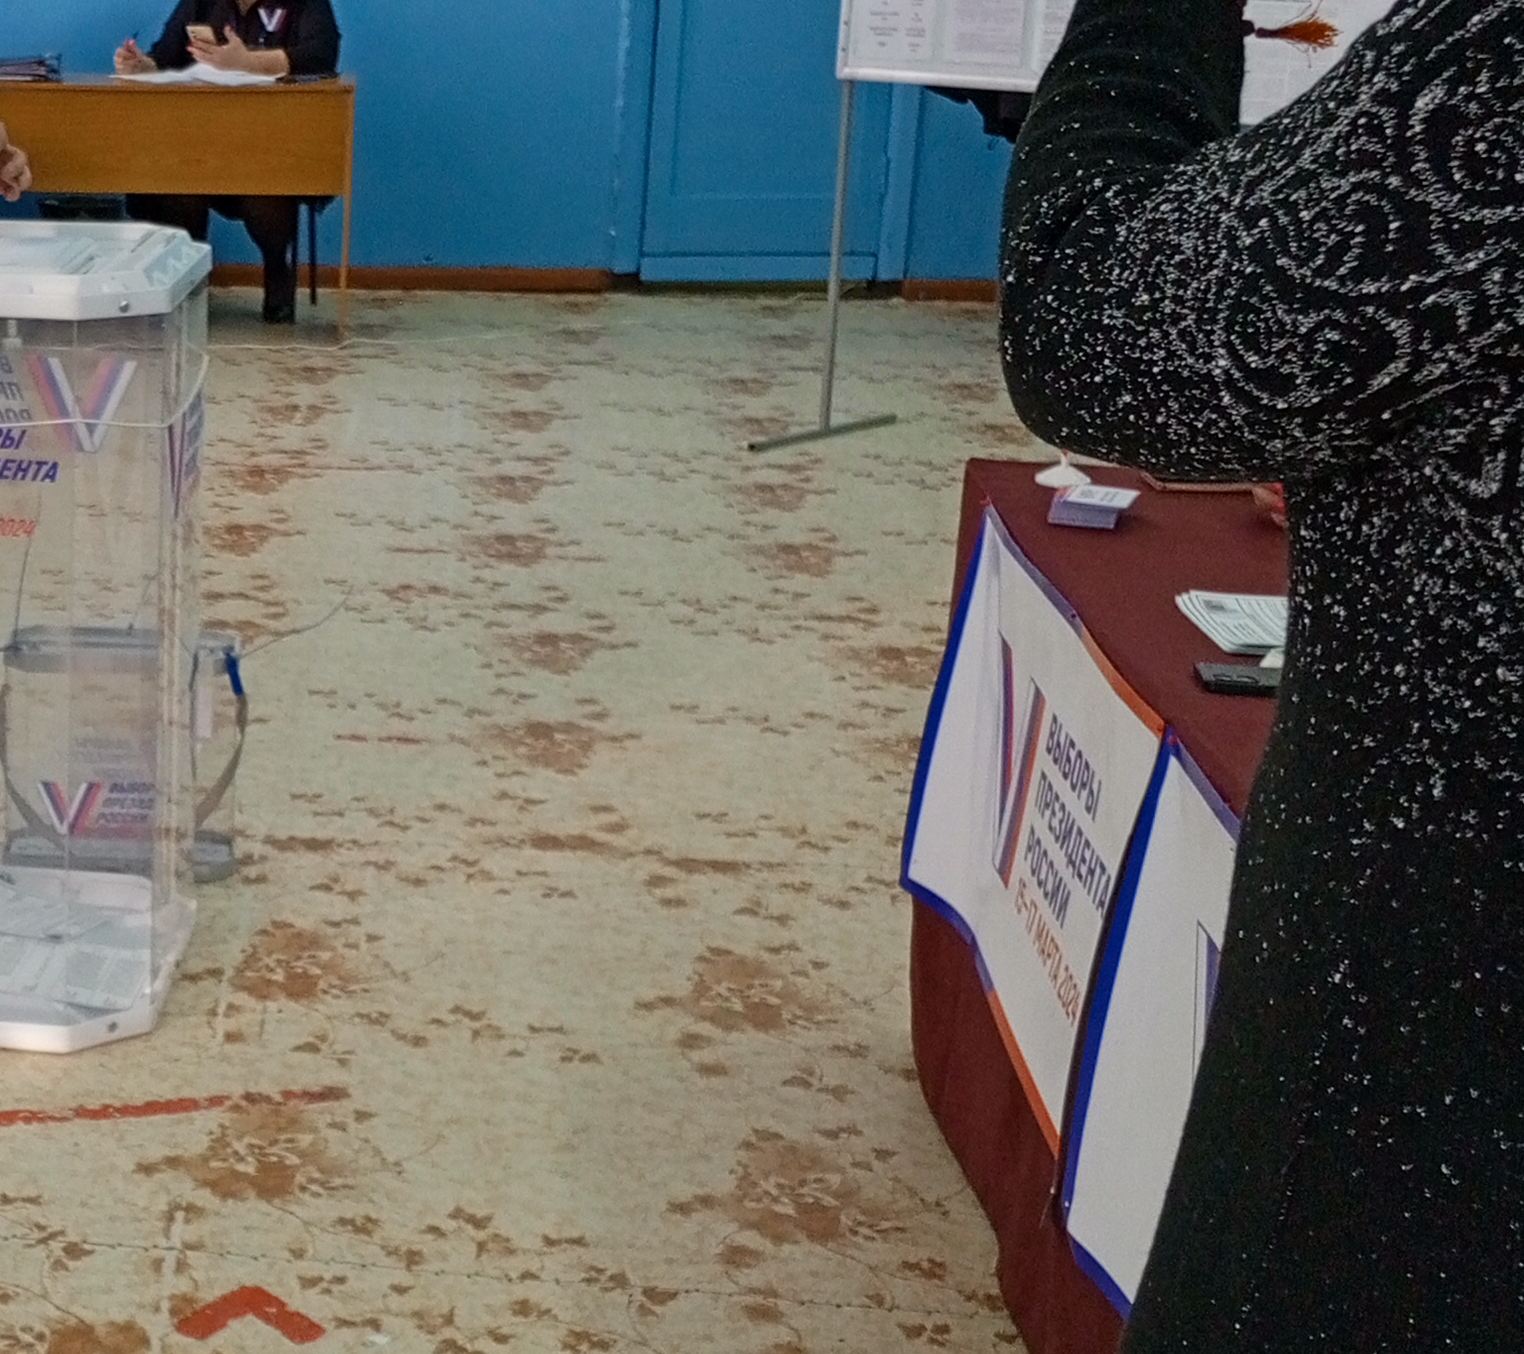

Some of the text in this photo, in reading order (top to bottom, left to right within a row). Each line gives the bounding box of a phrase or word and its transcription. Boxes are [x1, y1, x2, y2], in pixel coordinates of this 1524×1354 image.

[1045, 712, 1103, 823] ВЫБОРЫ
[1024, 823, 1072, 929] РОССИИ
[1035, 768, 1112, 921] ПРЕЗИДЕНТА
